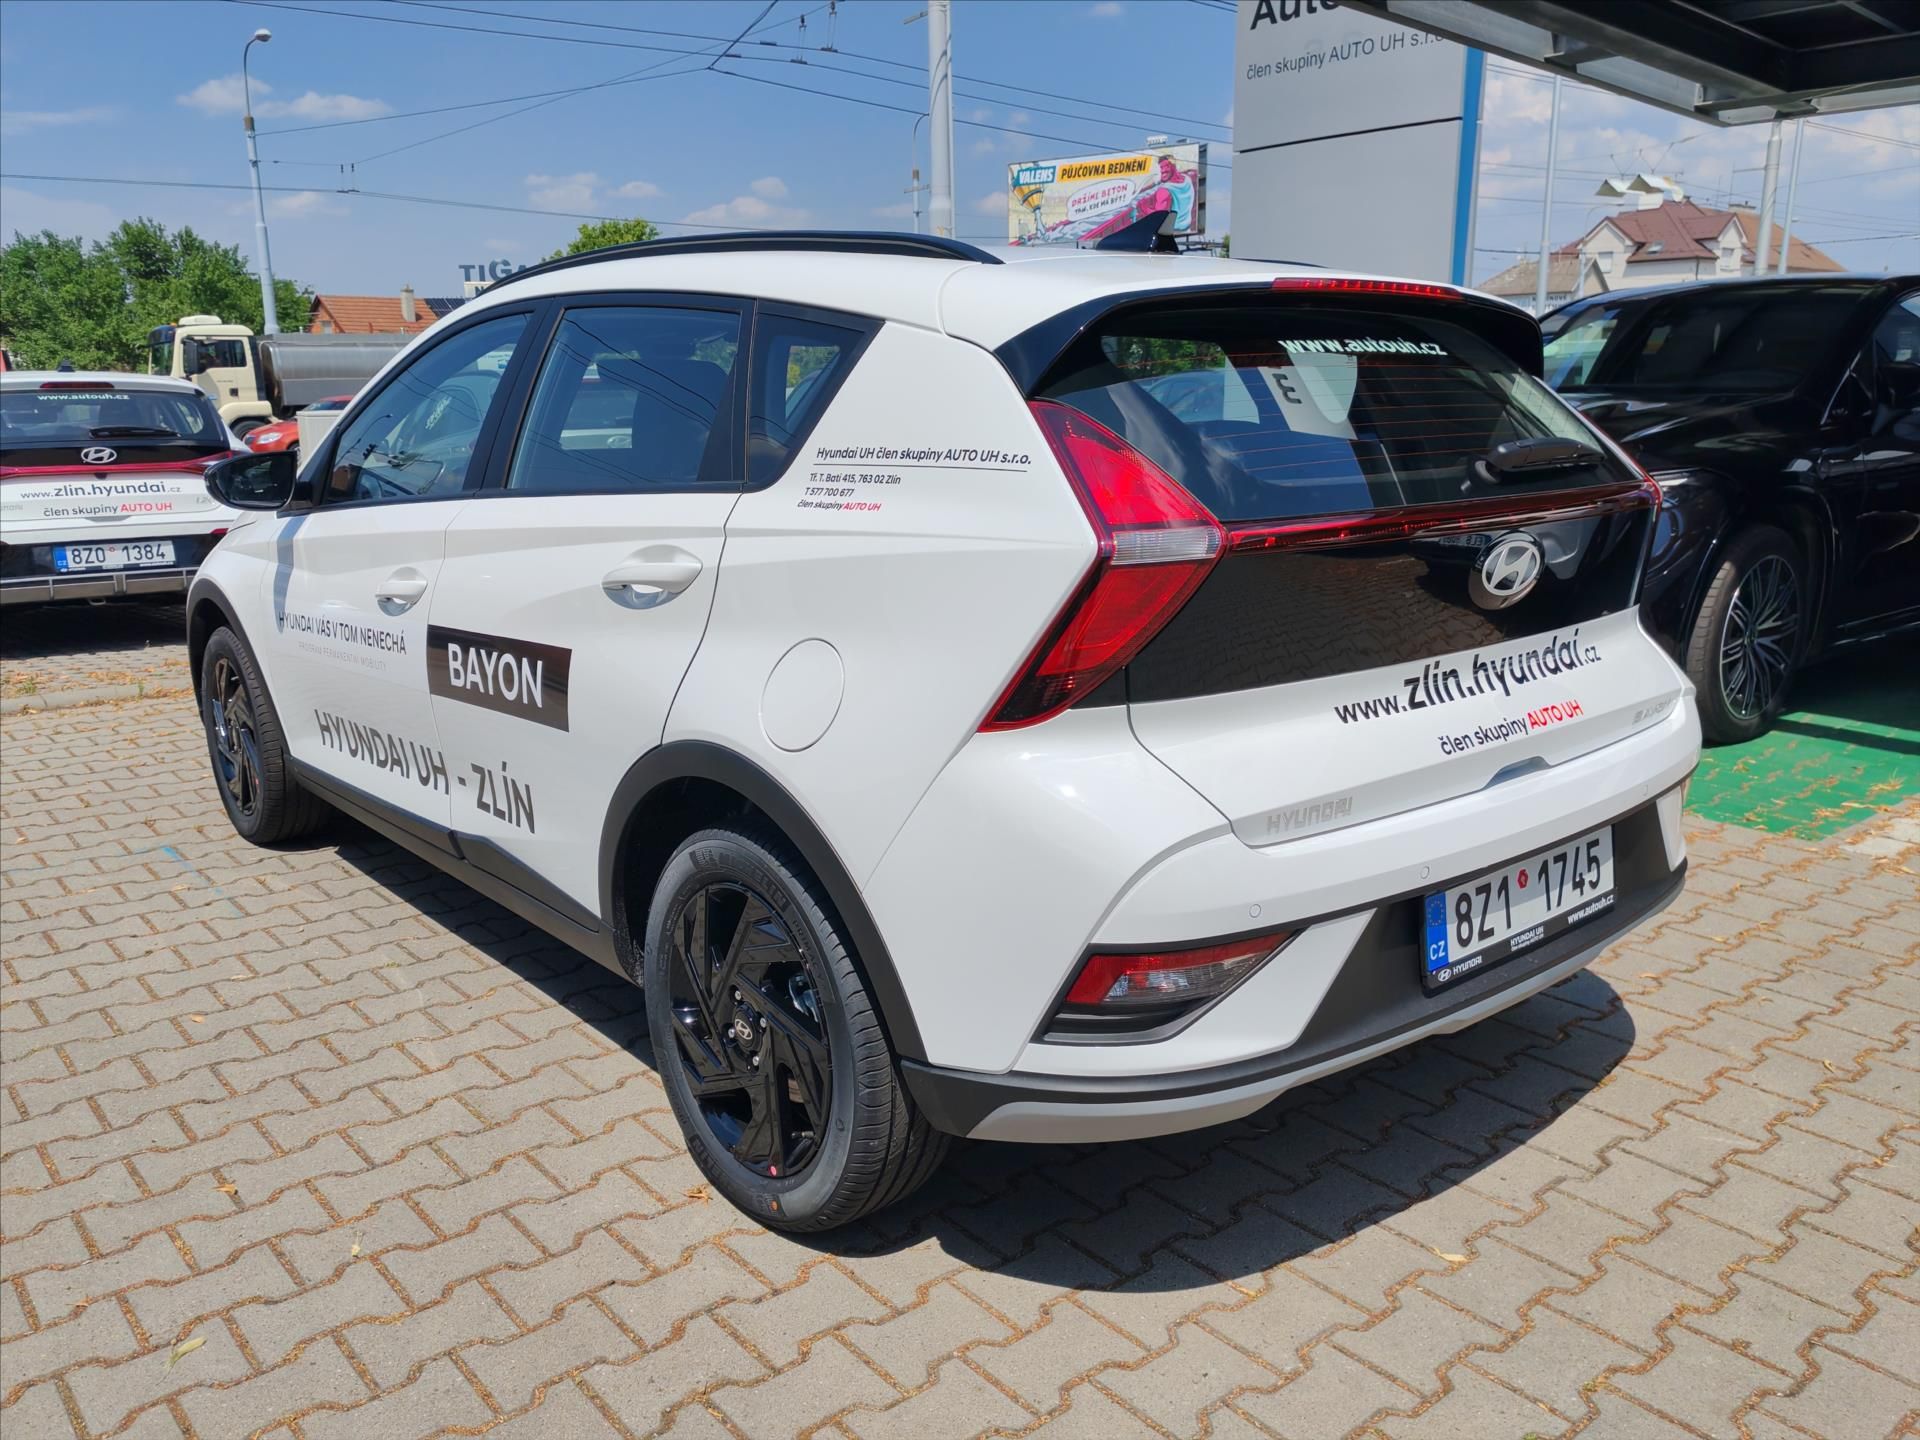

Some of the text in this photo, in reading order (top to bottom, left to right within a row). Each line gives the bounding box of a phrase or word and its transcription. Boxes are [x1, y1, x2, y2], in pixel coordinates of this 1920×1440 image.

[1247, 62, 1271, 79] člen
[1275, 51, 1326, 74] skupiny
[1329, 38, 1374, 62] AUTO
[1380, 32, 1404, 51] UH
[1061, 158, 1148, 179] PŮJČOVNA BEDNĚNÍ
[1101, 184, 1127, 197] BETON
[1278, 337, 1448, 356] www.autouh.cz
[816, 447, 1032, 465] Hyundai UH člen skupiny AUTO UH s.r.o.
[819, 473, 825, 482] T.
[842, 474, 856, 484] 415,
[858, 474, 873, 483] 763
[874, 474, 884, 483] 02
[885, 474, 901, 484] Zlín
[21, 481, 181, 498] www.zlin.hyundai.cz
[805, 487, 854, 497] T 577 700 677
[44, 502, 173, 517] člen skupiny AUTO UH
[798, 499, 881, 511] člen skupiny AUTO UH
[122, 544, 166, 562] 1384
[279, 611, 407, 655] HYUNDAI VÁS V TOM NENECHÁ
[447, 642, 543, 708] BAYON
[1334, 628, 1601, 724] www.zlin.hyundai.cz
[1438, 699, 1583, 755] člen skupiny AUTO UH
[314, 708, 410, 779] HYUNDAI
[409, 741, 450, 795] UH
[471, 760, 536, 834] ZLÍN
[1266, 796, 1353, 835] HYUNDAI
[1455, 838, 1601, 948] 8Z1 1745
[1567, 894, 1614, 925] www.autouh.cz
[1511, 928, 1536, 947] HYUNDAI
[1430, 941, 1446, 961] CZ
[1452, 955, 1482, 976] HYUNDAI
